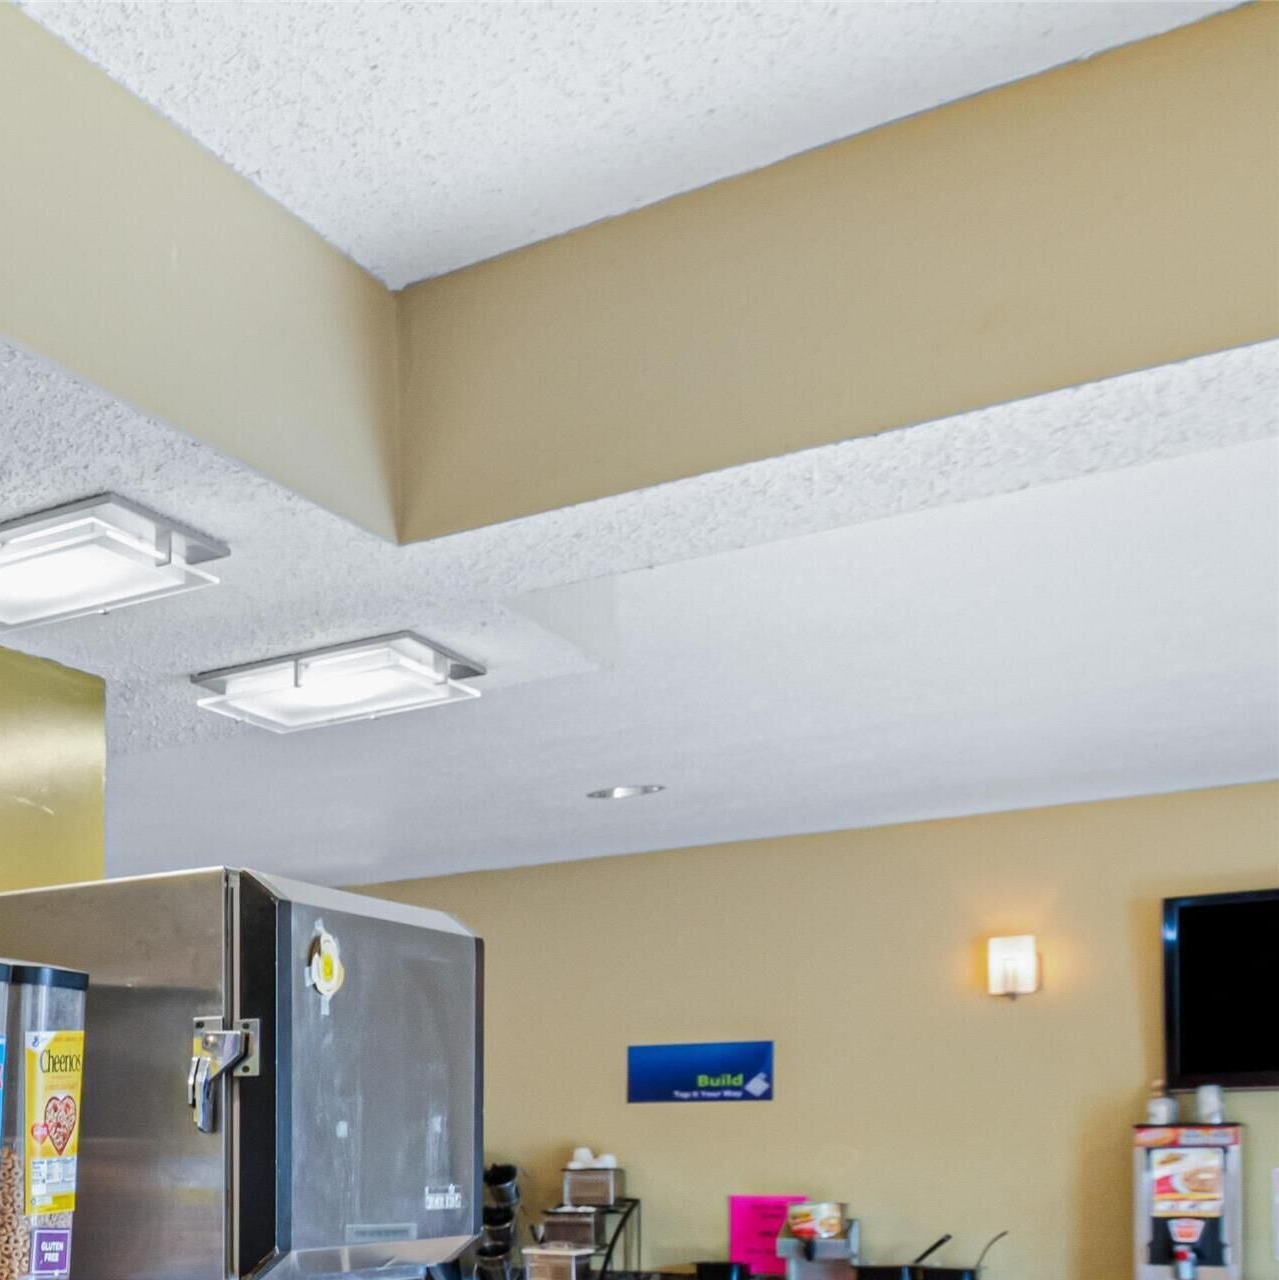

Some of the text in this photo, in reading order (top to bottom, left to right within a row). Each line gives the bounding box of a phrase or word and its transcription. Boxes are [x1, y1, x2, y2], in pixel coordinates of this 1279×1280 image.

[40, 1049, 81, 1073] Cheerios
[697, 1073, 743, 1087] Build
[40, 1241, 64, 1252] GLUTEN
[44, 1252, 59, 1263] FREE
